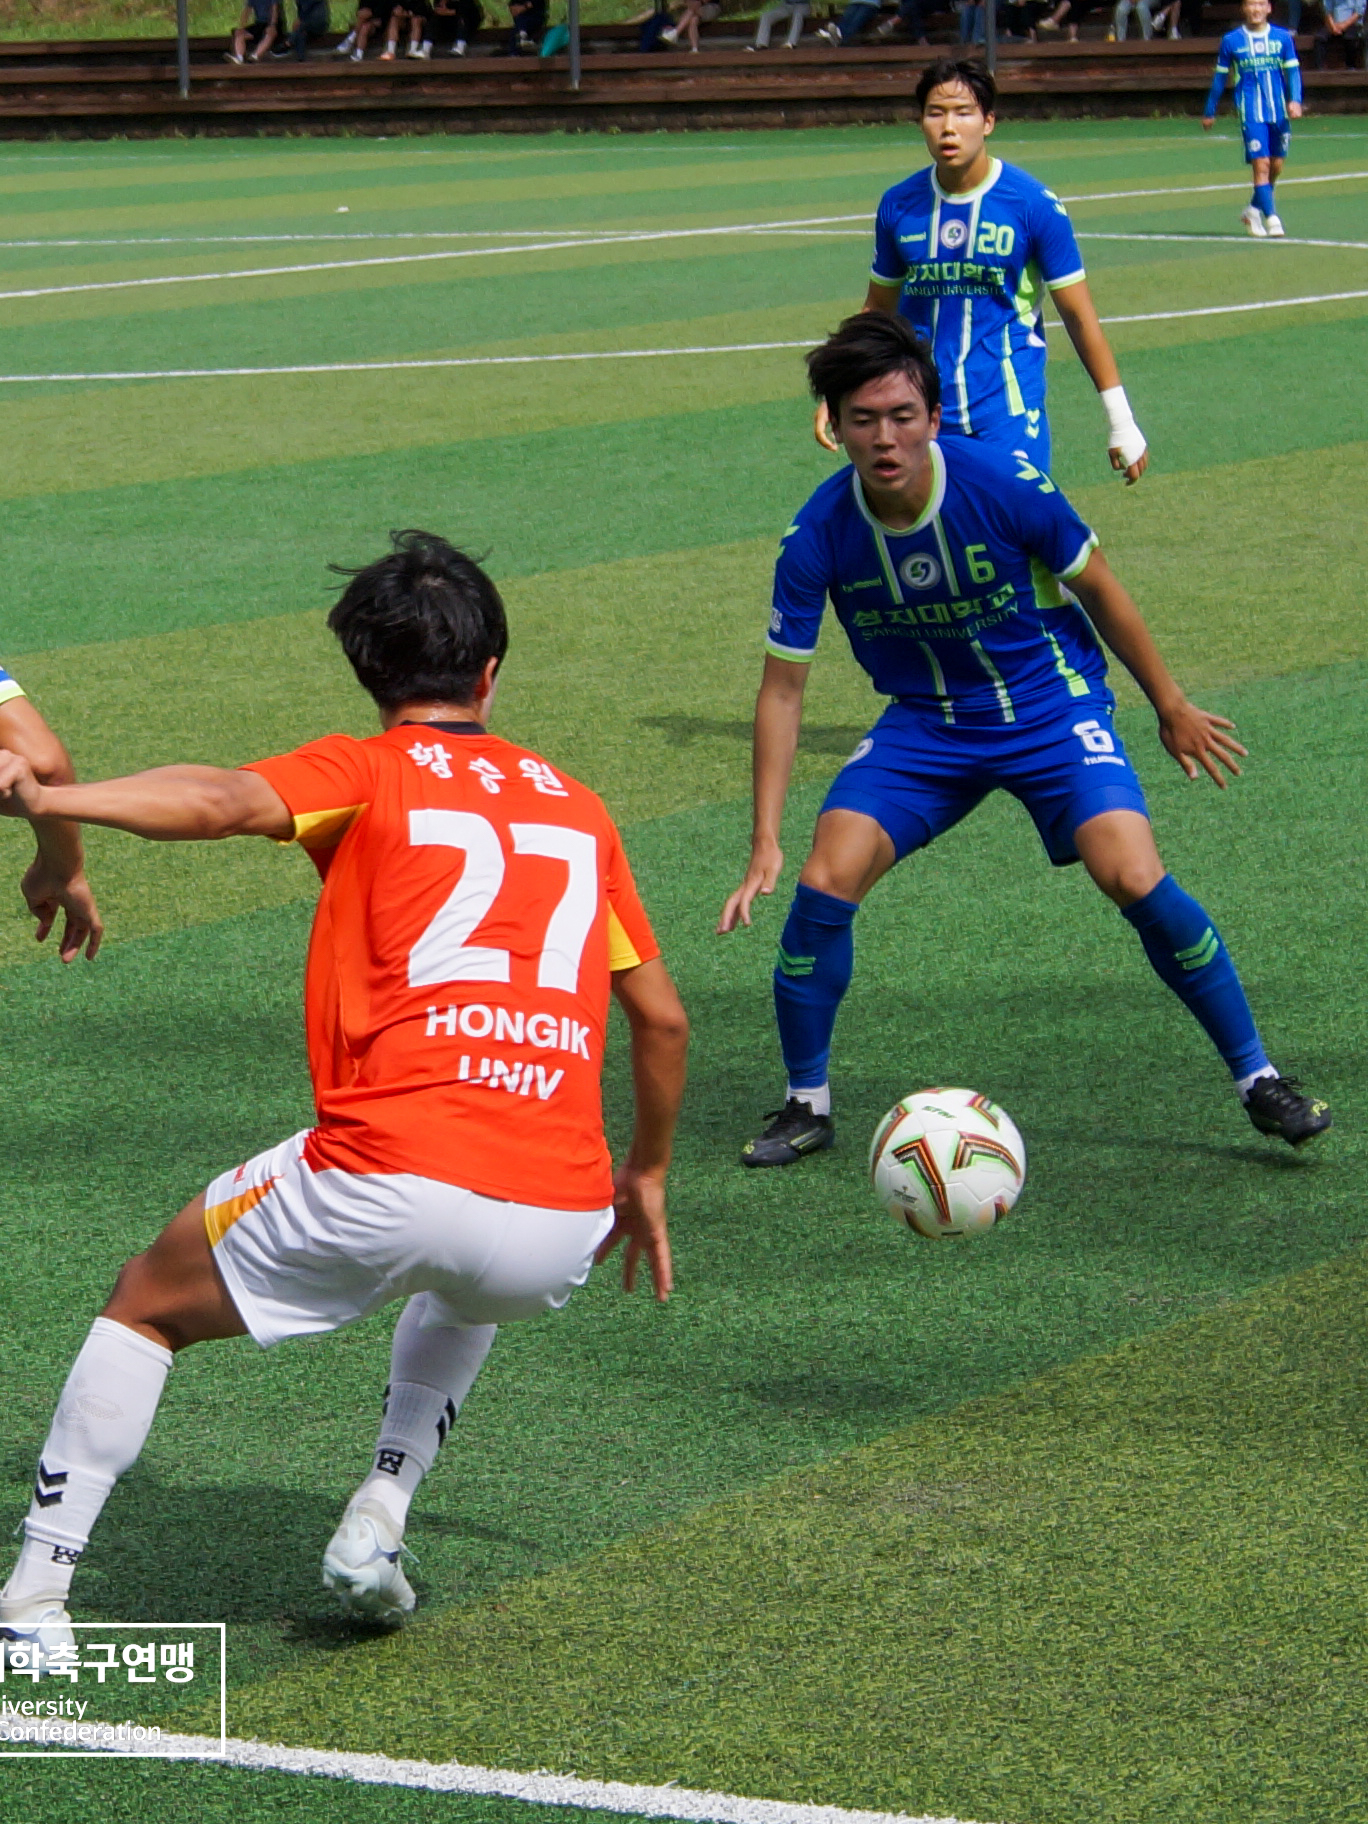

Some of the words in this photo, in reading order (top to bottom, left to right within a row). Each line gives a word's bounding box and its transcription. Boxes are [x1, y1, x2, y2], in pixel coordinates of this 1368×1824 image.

[978, 221, 1015, 256] 20
[966, 544, 996, 584] 6
[1072, 719, 1115, 753] 6
[408, 808, 598, 994] 27
[425, 1003, 591, 1061] HONGIK
[458, 1054, 565, 1101] UNIV
